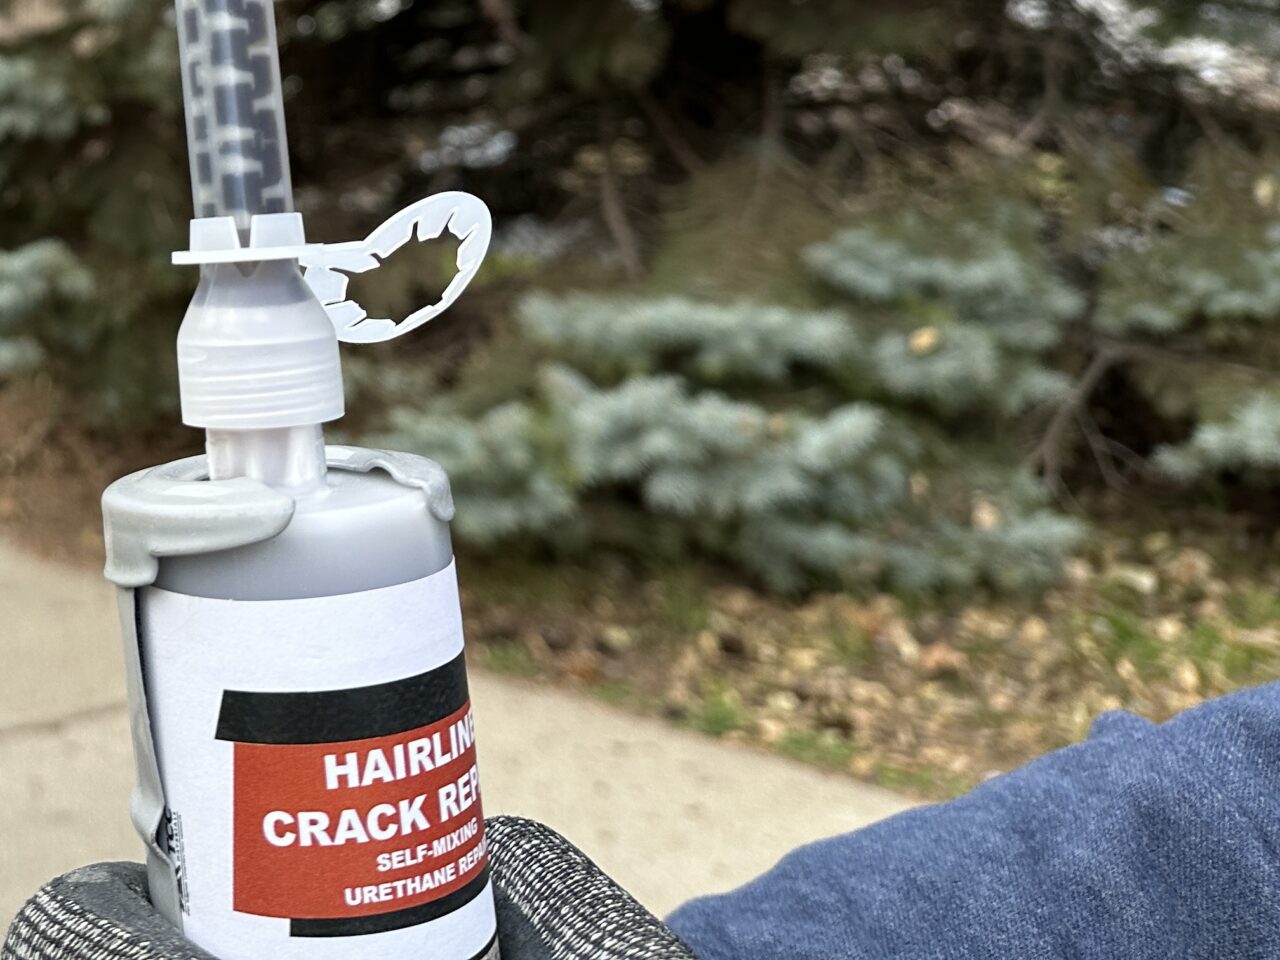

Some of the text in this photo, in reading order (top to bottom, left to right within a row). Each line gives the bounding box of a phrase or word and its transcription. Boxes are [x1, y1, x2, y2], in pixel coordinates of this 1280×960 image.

[262, 764, 480, 847] CRACK REP
[376, 817, 478, 873] SELF-MIXING
[344, 862, 457, 907] URETHANE
